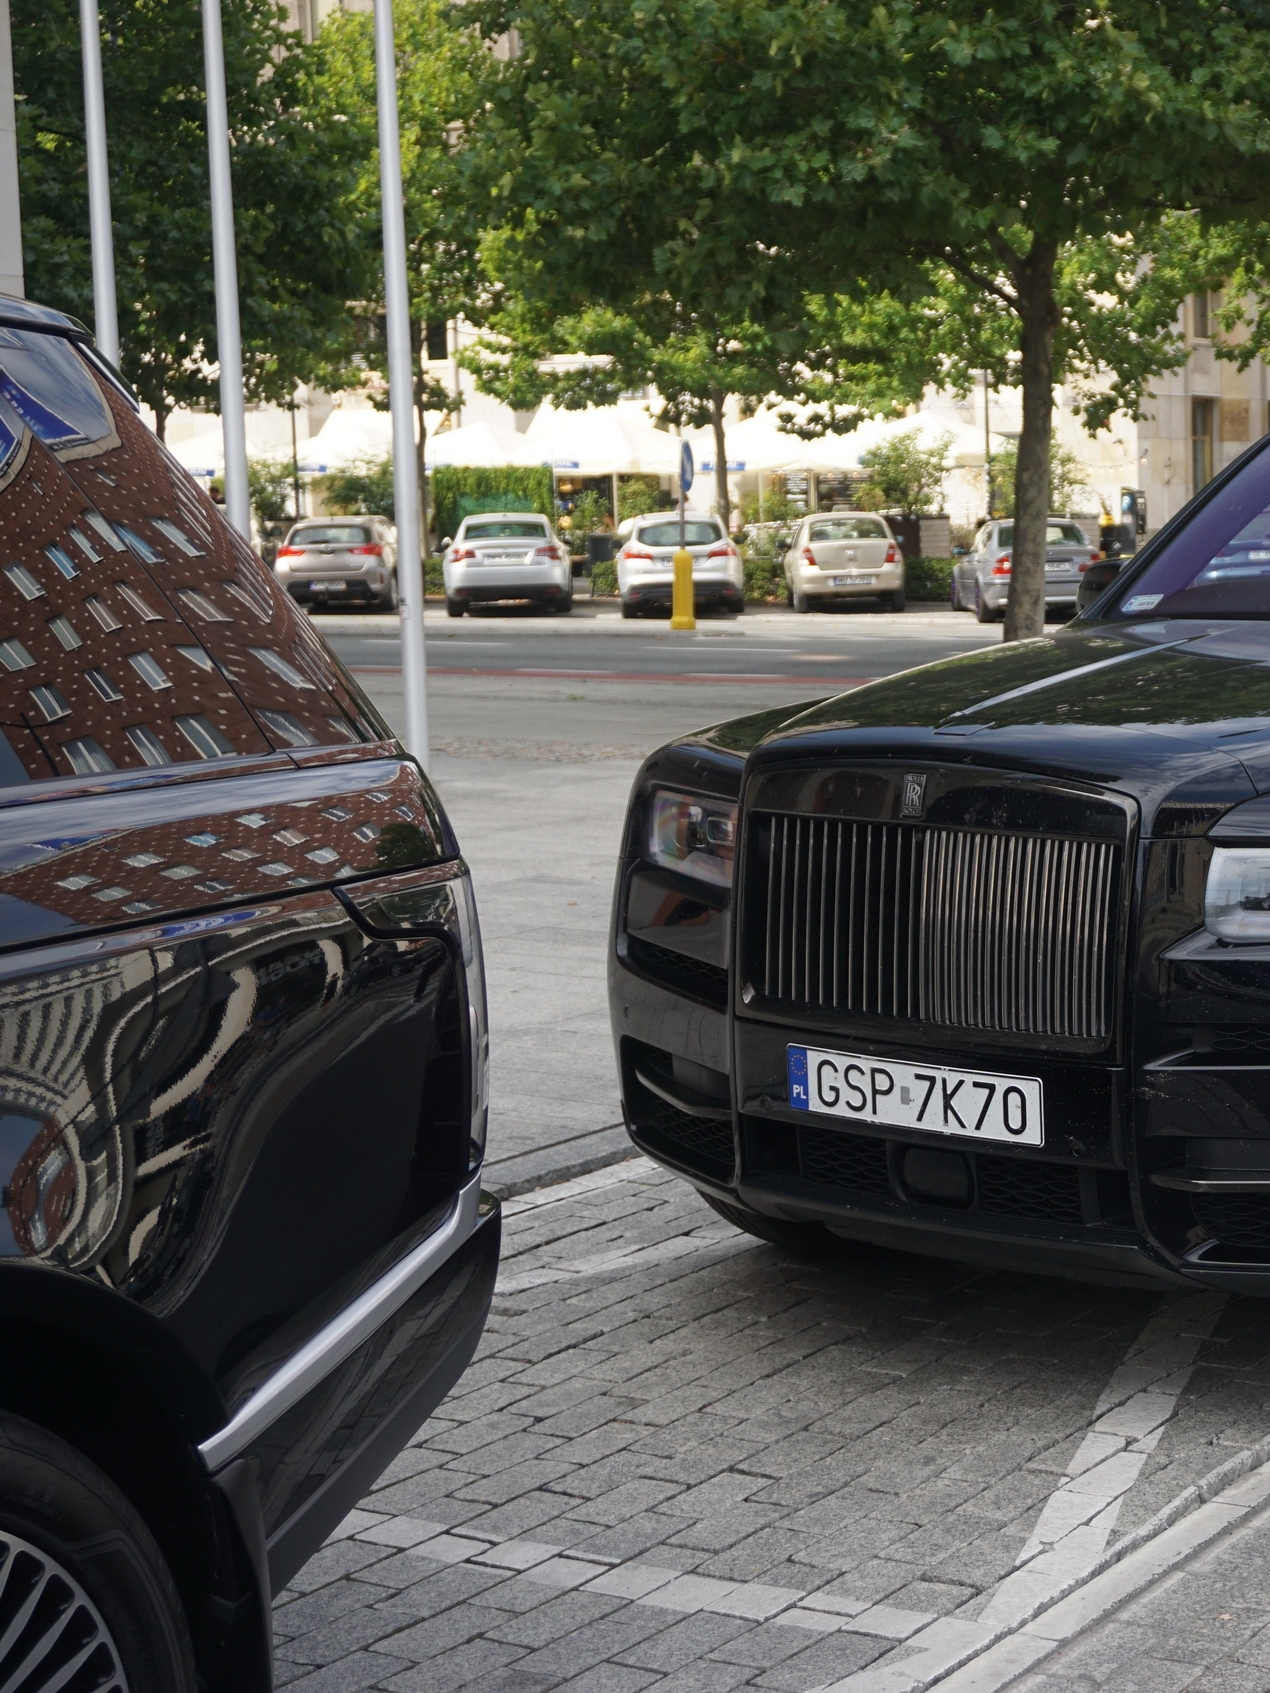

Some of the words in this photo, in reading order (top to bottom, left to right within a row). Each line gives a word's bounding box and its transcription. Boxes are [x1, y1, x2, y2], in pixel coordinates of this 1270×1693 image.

[792, 1084, 807, 1100] PL
[816, 1058, 895, 1115] GSP
[914, 1073, 1028, 1135] 7K70
